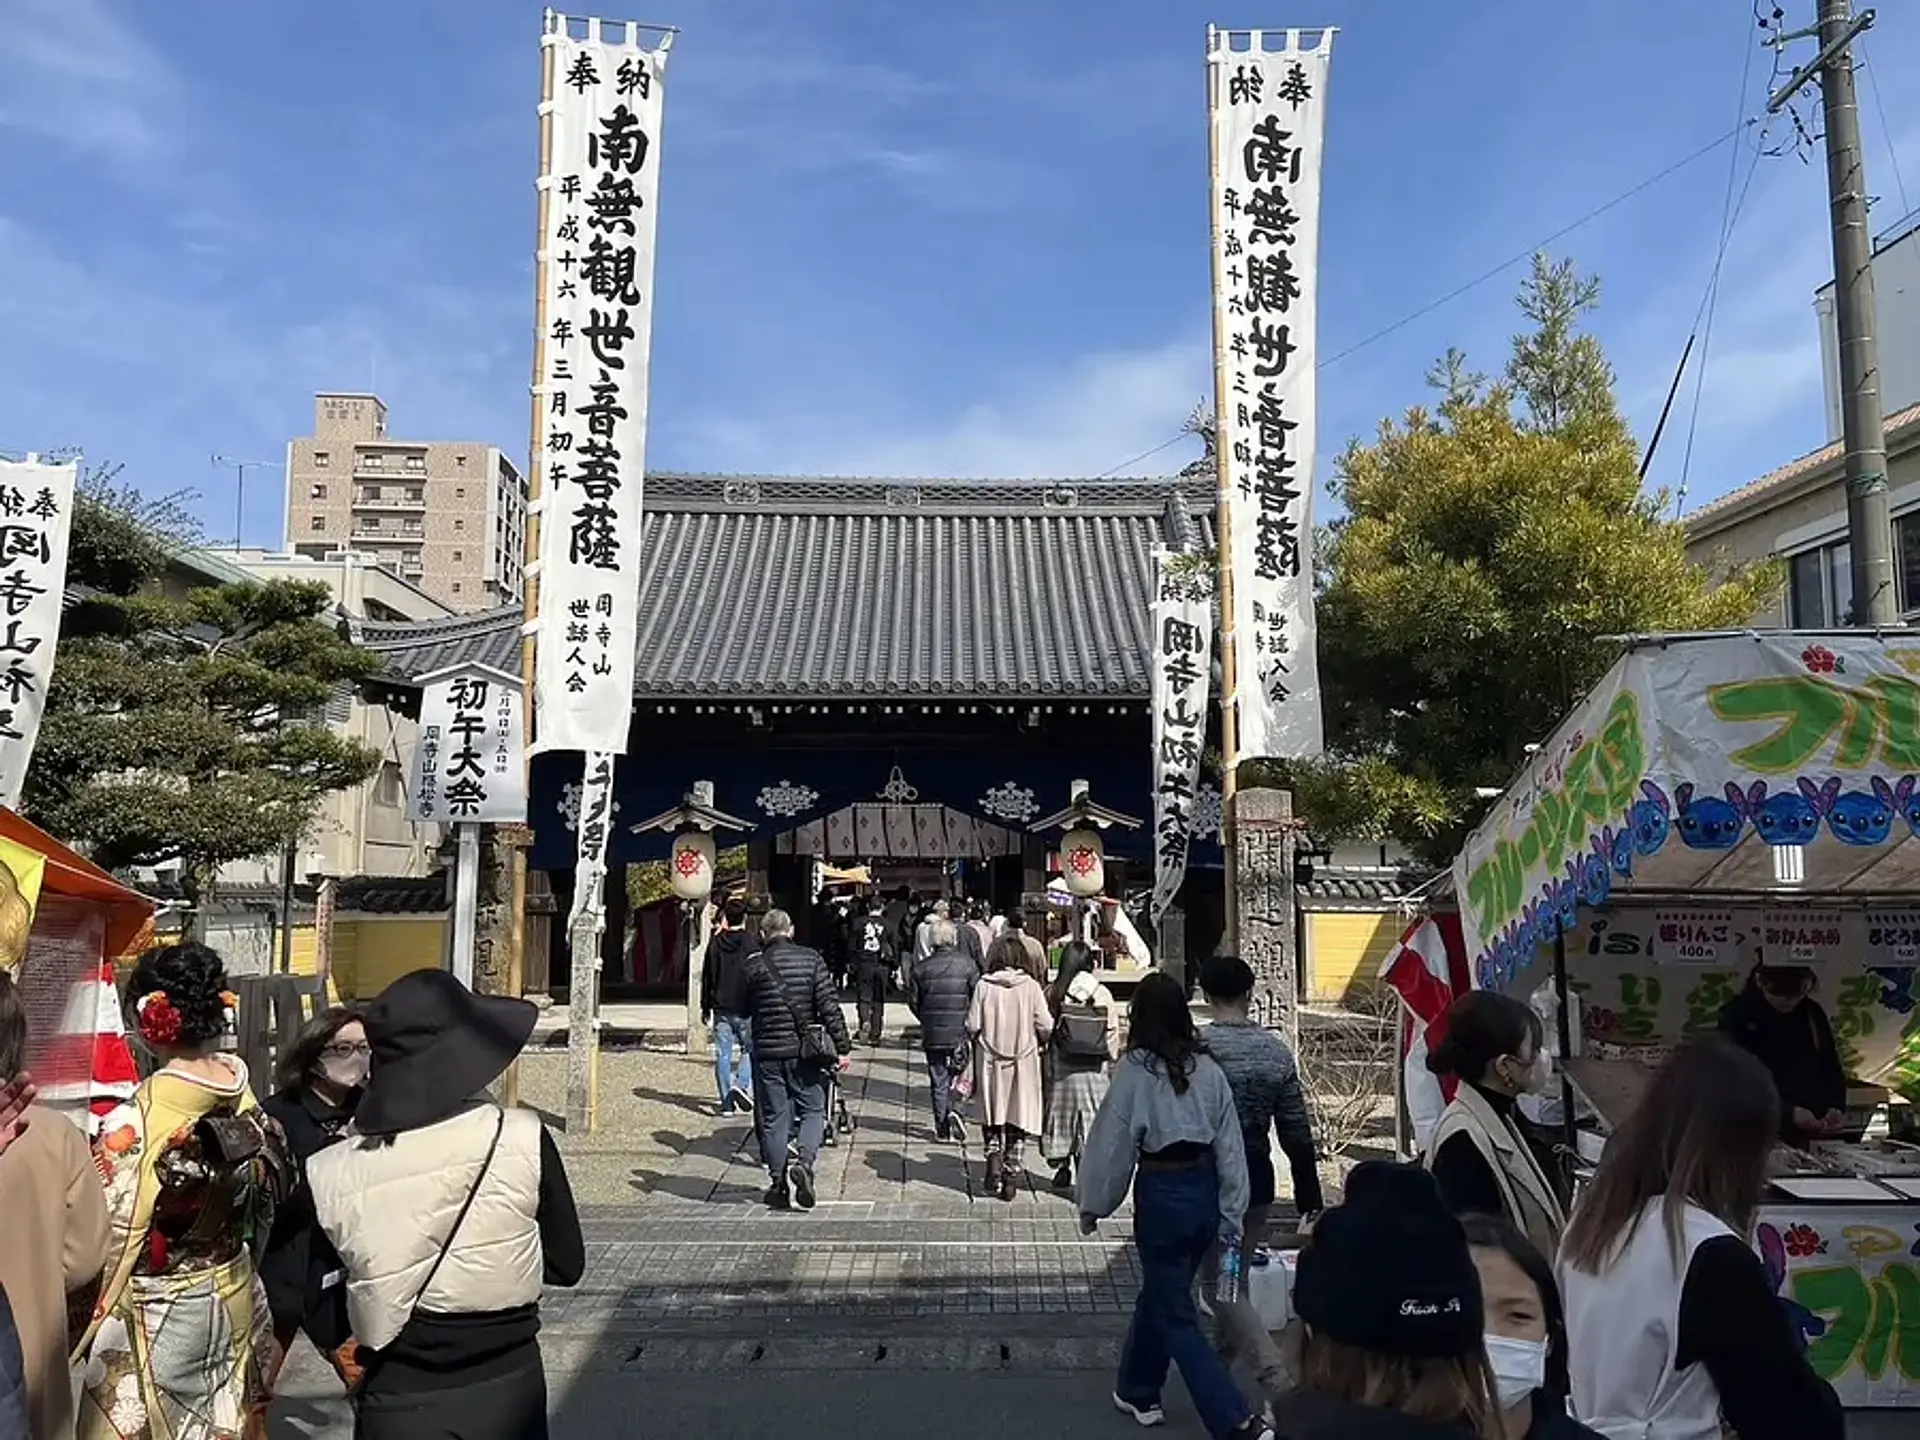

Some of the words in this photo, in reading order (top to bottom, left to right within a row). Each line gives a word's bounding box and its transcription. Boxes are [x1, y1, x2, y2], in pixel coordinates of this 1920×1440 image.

[565, 51, 651, 99] 奉納
[546, 175, 581, 491] 平成十六年三月初午
[569, 104, 649, 572] 南無観世音菩薩
[565, 599, 591, 693] 世話人会
[444, 678, 488, 816] 初午大祭
